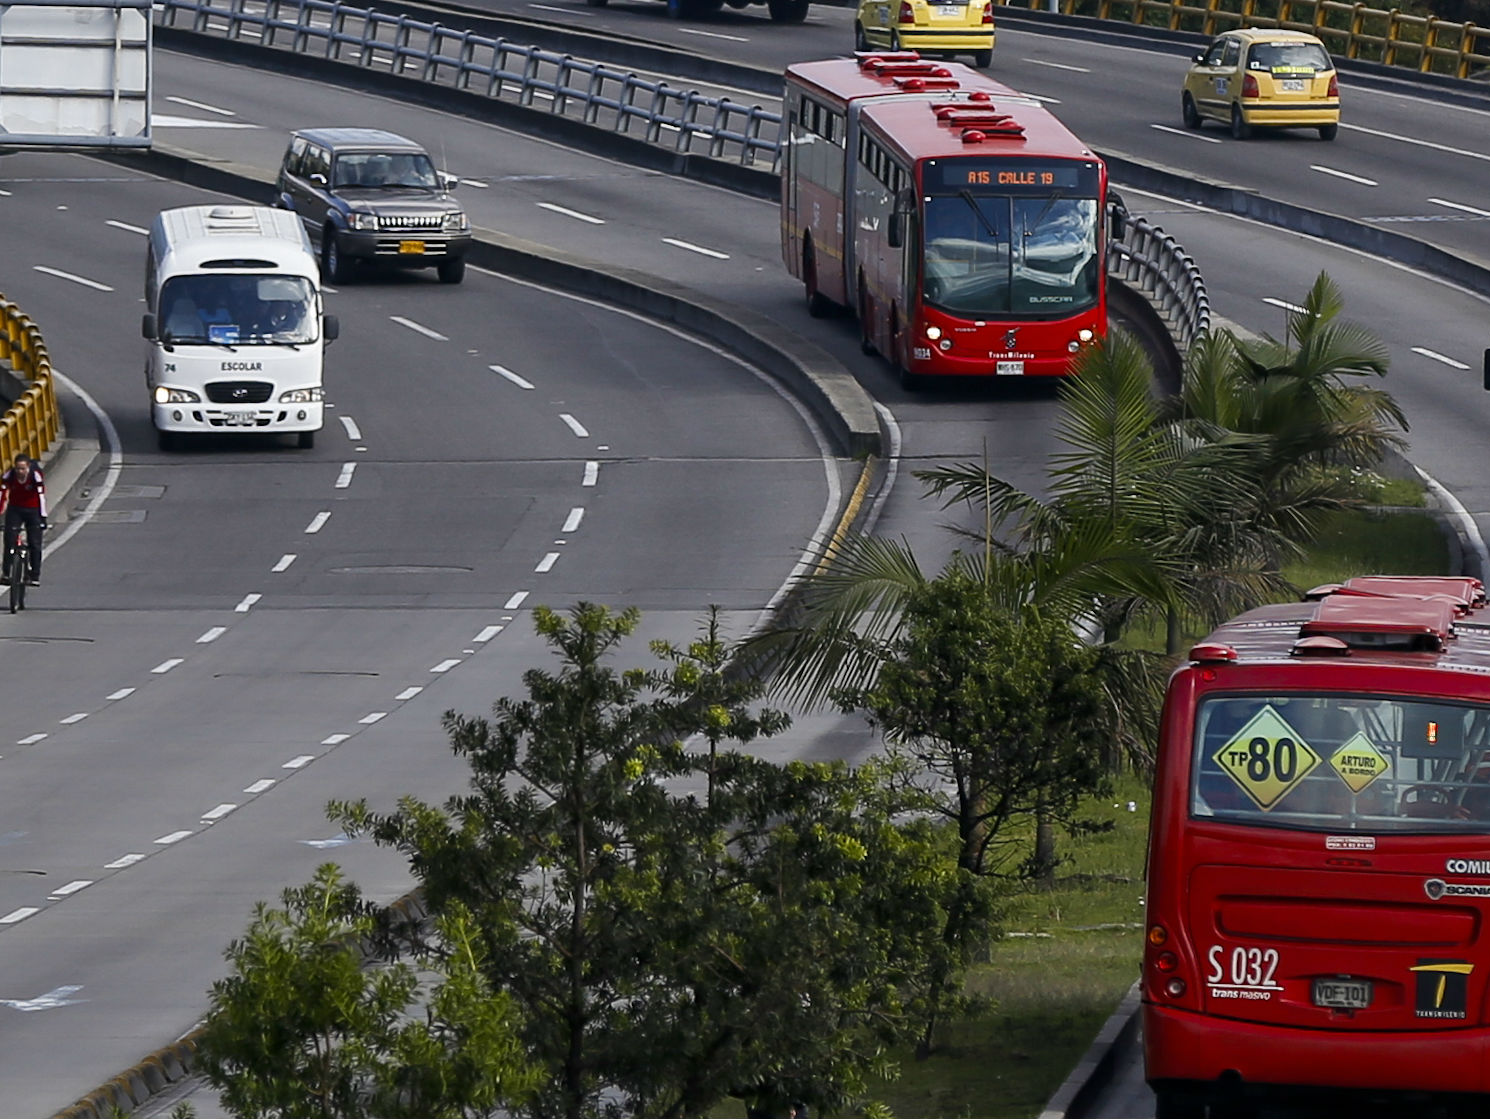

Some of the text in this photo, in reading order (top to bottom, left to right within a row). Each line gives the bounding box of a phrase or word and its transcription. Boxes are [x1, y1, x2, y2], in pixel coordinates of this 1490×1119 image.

[968, 171, 1054, 184] A15 CALLE 19
[221, 361, 262, 372] ESCOLAR
[1228, 737, 1298, 783] TP 80
[1340, 755, 1377, 768] ARTURO
[1207, 944, 1280, 986] S 032
[1212, 988, 1238, 999] trans
